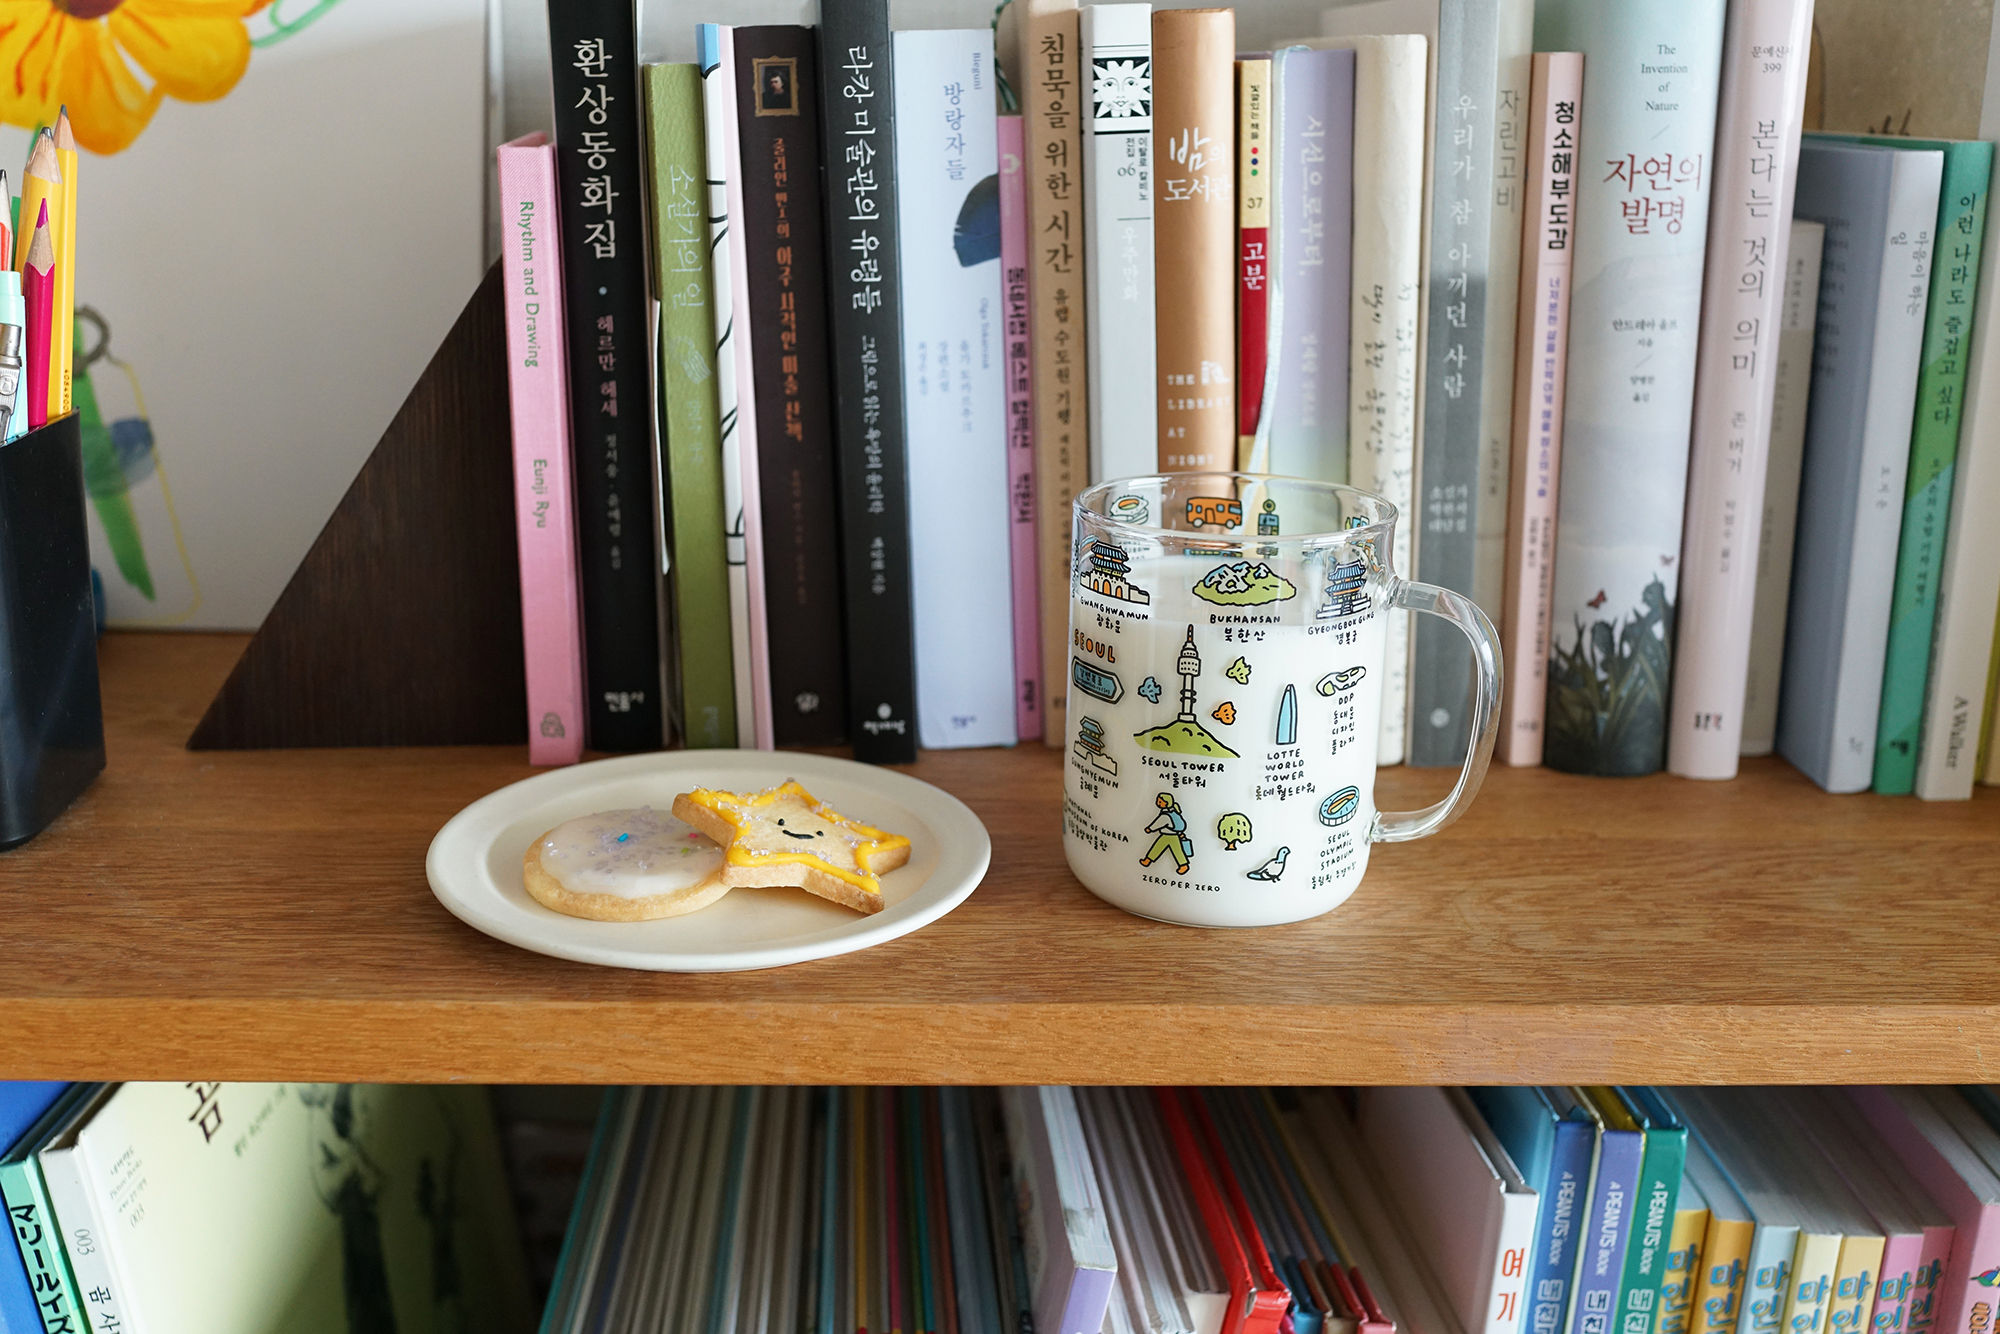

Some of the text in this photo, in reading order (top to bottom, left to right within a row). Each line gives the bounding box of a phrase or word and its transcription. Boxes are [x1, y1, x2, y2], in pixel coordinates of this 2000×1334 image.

[1657, 44, 1677, 55] The
[1640, 63, 1688, 75] Invention
[1762, 62, 1782, 73] 399
[1657, 81, 1671, 92] of
[1645, 100, 1680, 112] Nature
[943, 82, 967, 181] 방랑자들
[572, 37, 620, 260] 환상동화집
[1040, 32, 1074, 275] 침묵을 위한 시간
[1495, 89, 1519, 214] 자린고비
[841, 45, 882, 314] 라캉 미술관의 유령들
[1603, 153, 1703, 194] 자연의
[1163, 175, 1232, 203] 도서관
[1246, 197, 1263, 209] 37
[1957, 192, 1976, 235] 이런
[1621, 196, 1685, 235] 발명
[666, 164, 705, 310] 소설가의 일
[1443, 94, 1477, 399] 우리가 참 아끼던 사람
[1732, 119, 1779, 380] 본다는 것의 의미
[1242, 242, 1266, 290] 고분
[1946, 243, 1972, 306] 나라도
[516, 201, 540, 368] Rhythm and Drawing
[1934, 385, 1954, 425] 싶다
[1167, 428, 1186, 438] AT
[532, 459, 549, 528] Eunji Ryu
[1079, 595, 1150, 621] GWANGHWAMUN
[1209, 613, 1281, 625] BUKHANSAN
[1096, 613, 1122, 634] 광화문
[1224, 627, 1266, 644] 북한산
[1073, 628, 1116, 664] SEOUL
[1335, 630, 1358, 646] 경복궁
[1338, 692, 1355, 706] DDP
[1333, 705, 1355, 726] 동대문
[1331, 721, 1355, 736] 디자인
[1141, 755, 1225, 774] SEOUL TOWER
[1264, 758, 1305, 772] WORLD
[1266, 747, 1301, 761] LOTTE
[1070, 756, 1120, 789] SUNGNYEMUN
[1159, 770, 1207, 789] 서울타워
[1263, 770, 1305, 783] TOWER
[1079, 775, 1099, 799] 숭례문
[1090, 822, 1099, 833] OF
[1101, 826, 1130, 843] KOREA
[1327, 829, 1351, 845] SEOUL
[1320, 838, 1353, 858] OLYMPIC
[1320, 847, 1355, 871] STADIUM
[1142, 873, 1221, 893] ZERO PER ZERO
[1549, 1171, 1577, 1266] A PEANUTS BOOK
[1595, 1180, 1624, 1276] A PEANUTS BOOK
[1639, 1180, 1669, 1275] A PEANUTS BOOK
[74, 1227, 96, 1257] 003
[1496, 1247, 1526, 1322] 여기
[1537, 1278, 1565, 1301] 내
[1704, 1257, 1746, 1334] 마인
[1584, 1289, 1611, 1313] 내
[1627, 1288, 1655, 1311] 내
